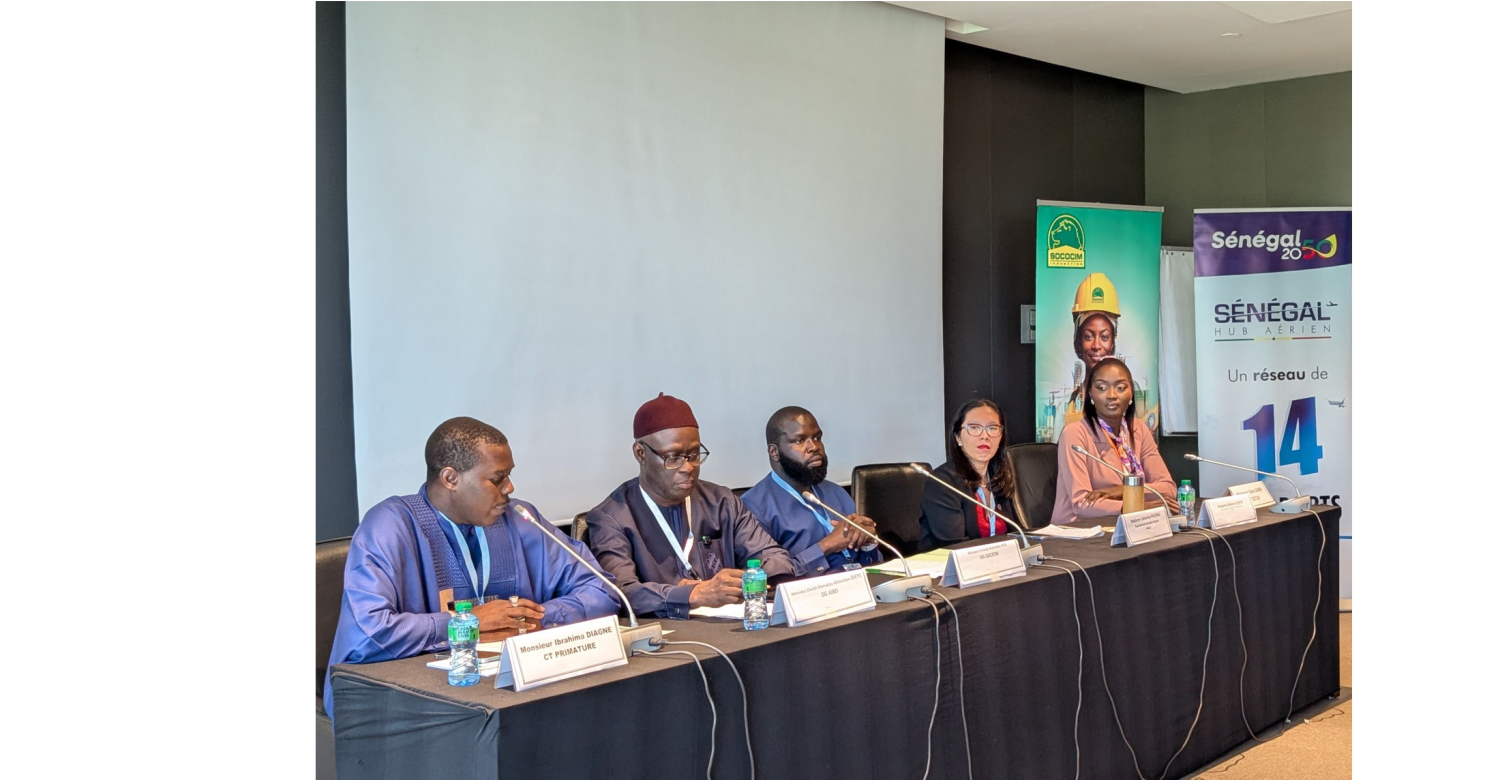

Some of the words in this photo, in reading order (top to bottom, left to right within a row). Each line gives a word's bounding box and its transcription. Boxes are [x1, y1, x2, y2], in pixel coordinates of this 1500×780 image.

[1211, 229, 1301, 252] Sénégal
[1281, 234, 1338, 260] 2050
[1050, 252, 1083, 260] SOCOCIM
[1214, 298, 1331, 323] SÉNÉGAL
[1214, 326, 1248, 336] HUB
[1265, 324, 1331, 335] AÉRIEN
[1228, 369, 1247, 382] Un
[1253, 368, 1306, 382] réseau
[1311, 366, 1328, 380] de
[1241, 396, 1323, 481] 14
[520, 641, 552, 653] Monsieur
[555, 634, 585, 646] Ibrahima
[586, 626, 613, 639] DIAGNE
[543, 652, 553, 661] CT
[555, 642, 597, 659] PRIMATURE
